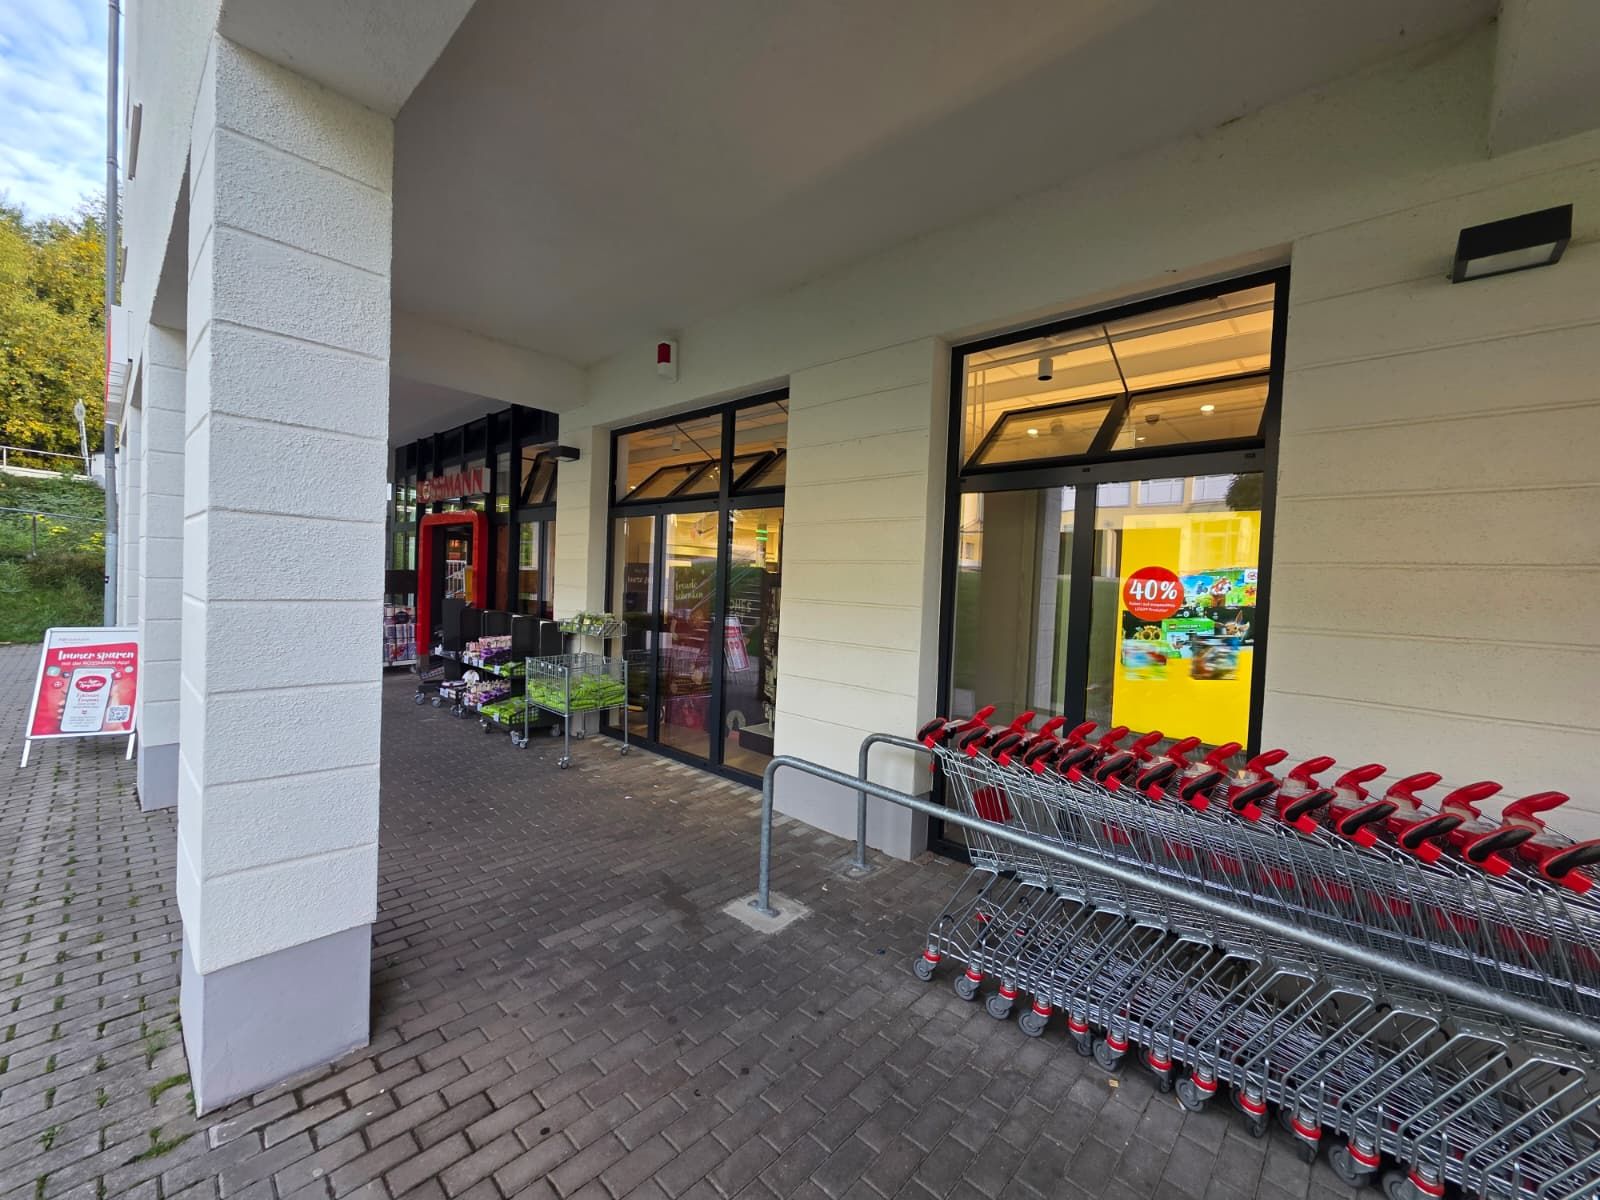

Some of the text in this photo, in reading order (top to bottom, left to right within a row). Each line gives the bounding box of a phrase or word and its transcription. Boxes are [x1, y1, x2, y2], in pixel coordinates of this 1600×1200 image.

[1129, 579, 1178, 600] 40%
[58, 650, 134, 661] Immer sparen
